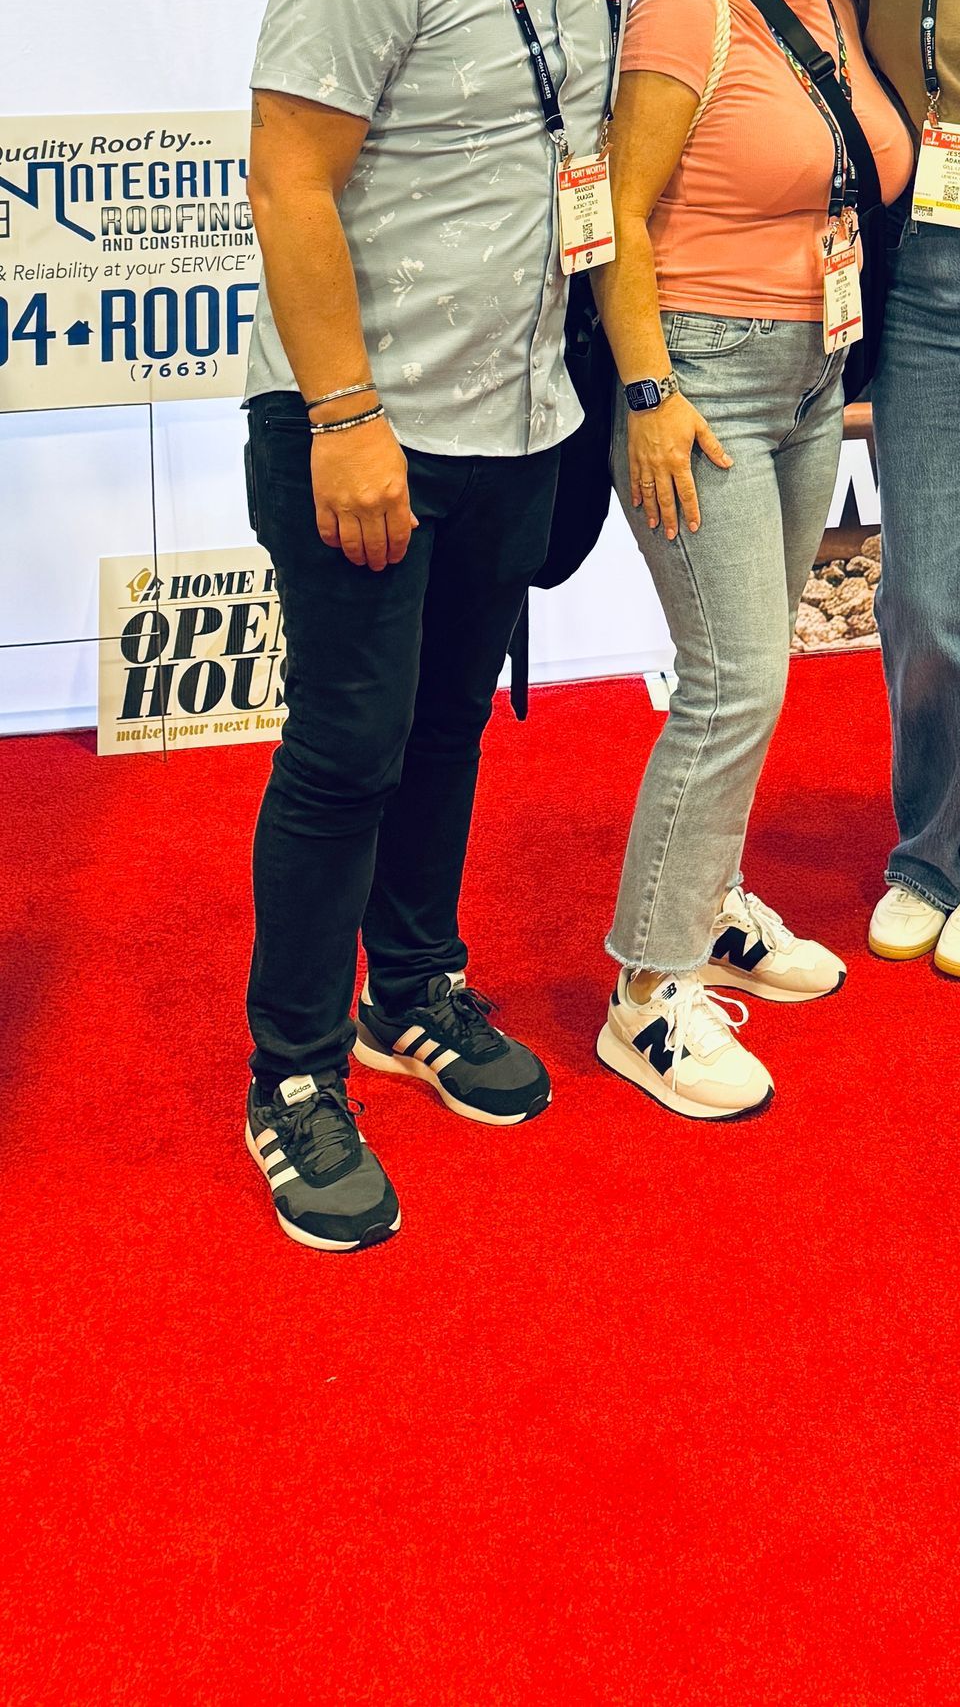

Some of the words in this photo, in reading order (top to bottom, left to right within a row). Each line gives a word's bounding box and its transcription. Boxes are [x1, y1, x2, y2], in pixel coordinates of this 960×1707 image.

[90, 130, 155, 155] Roof
[160, 130, 212, 152] by...
[941, 134, 960, 143] FORT
[101, 201, 252, 236] ROOFING
[102, 238, 133, 252] AND
[140, 233, 254, 250] CONSTRUCTION
[13, 261, 98, 282] Reliability
[103, 263, 121, 276] at
[125, 261, 165, 280] your
[0, 292, 56, 366] 4
[101, 282, 260, 362] ROOF
[130, 360, 218, 382] (7663)
[168, 570, 255, 599] HOME
[116, 655, 288, 721] HOU
[116, 724, 163, 742] make
[168, 722, 208, 741] your
[213, 716, 250, 734] next
[255, 714, 285, 731] hou
[287, 1083, 311, 1098] adidas
